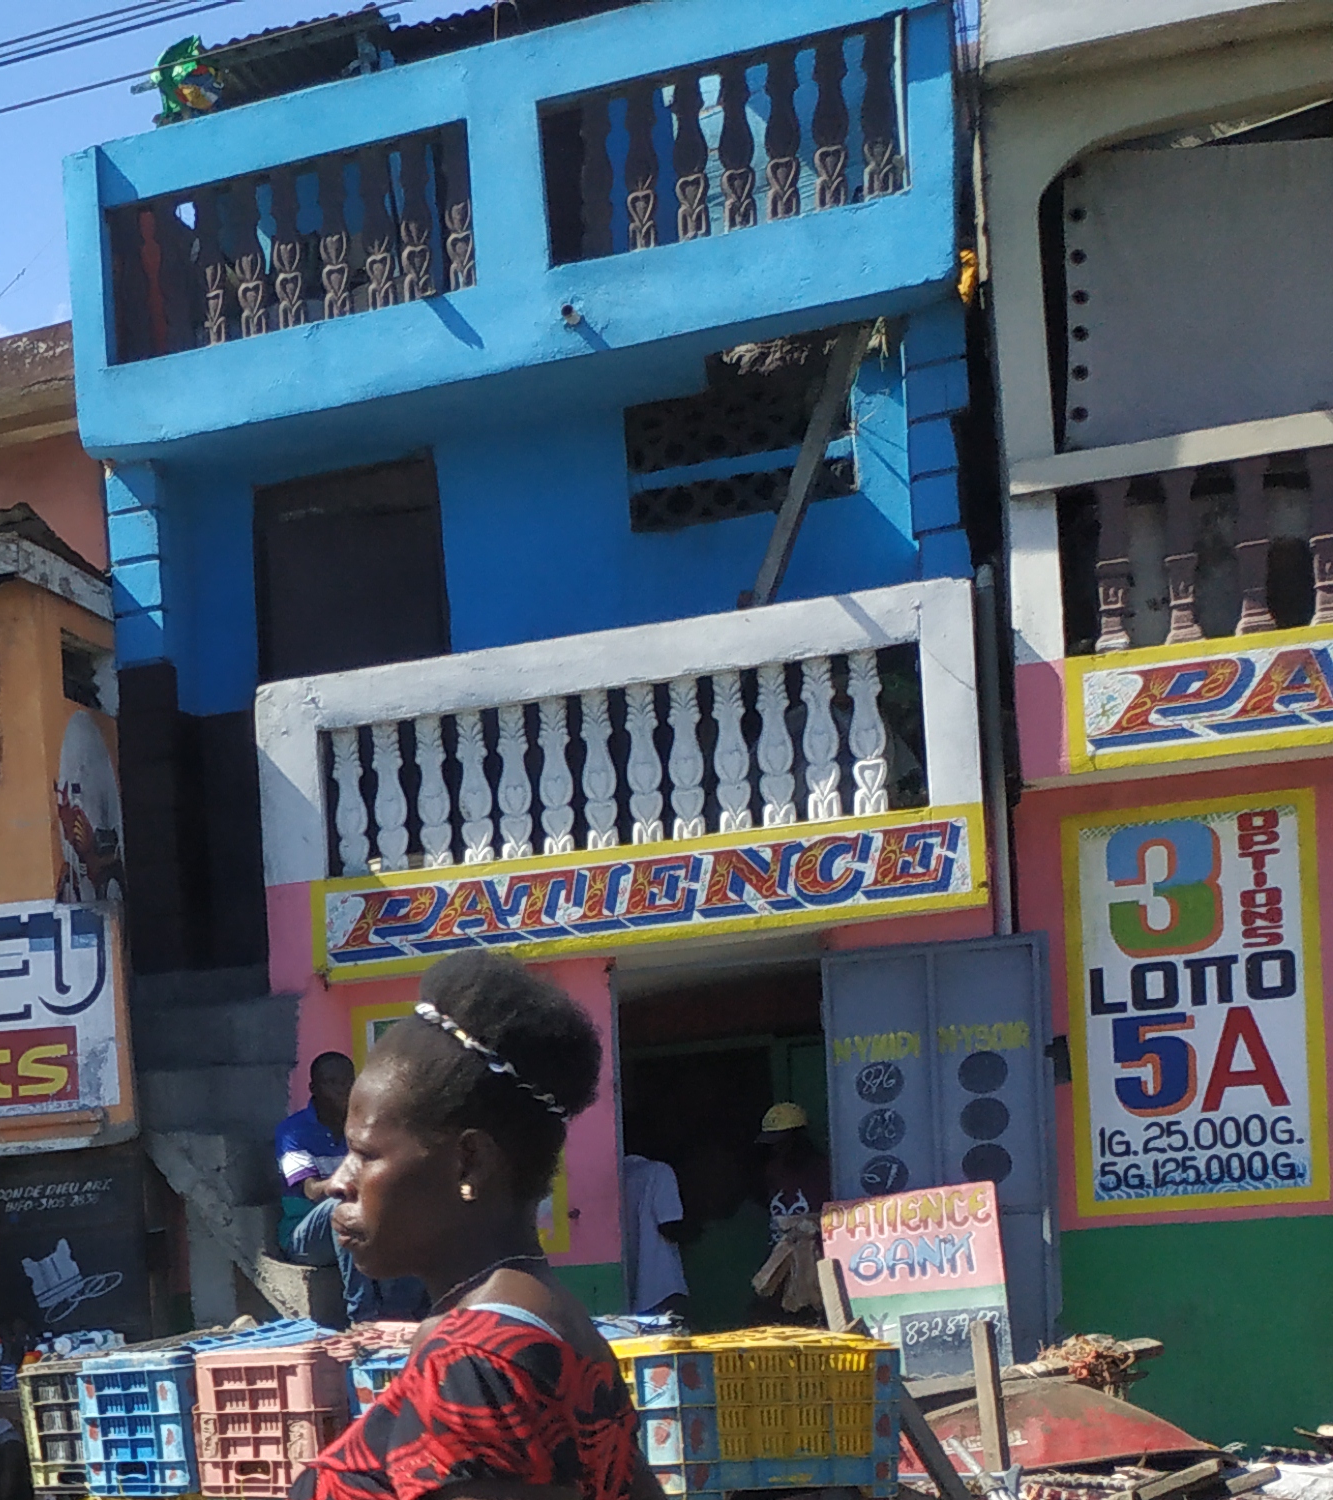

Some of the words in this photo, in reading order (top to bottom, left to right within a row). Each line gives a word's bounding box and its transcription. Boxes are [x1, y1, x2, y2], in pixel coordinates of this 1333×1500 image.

[334, 819, 962, 961] PATIENCE
[1106, 820, 1224, 958] 3
[1237, 809, 1285, 949] OPTIONS
[1089, 949, 1297, 1016] LOTTO
[45, 1181, 80, 1196] DIEU
[822, 1187, 994, 1243] PATIENCE
[848, 1230, 977, 1284] BANK
